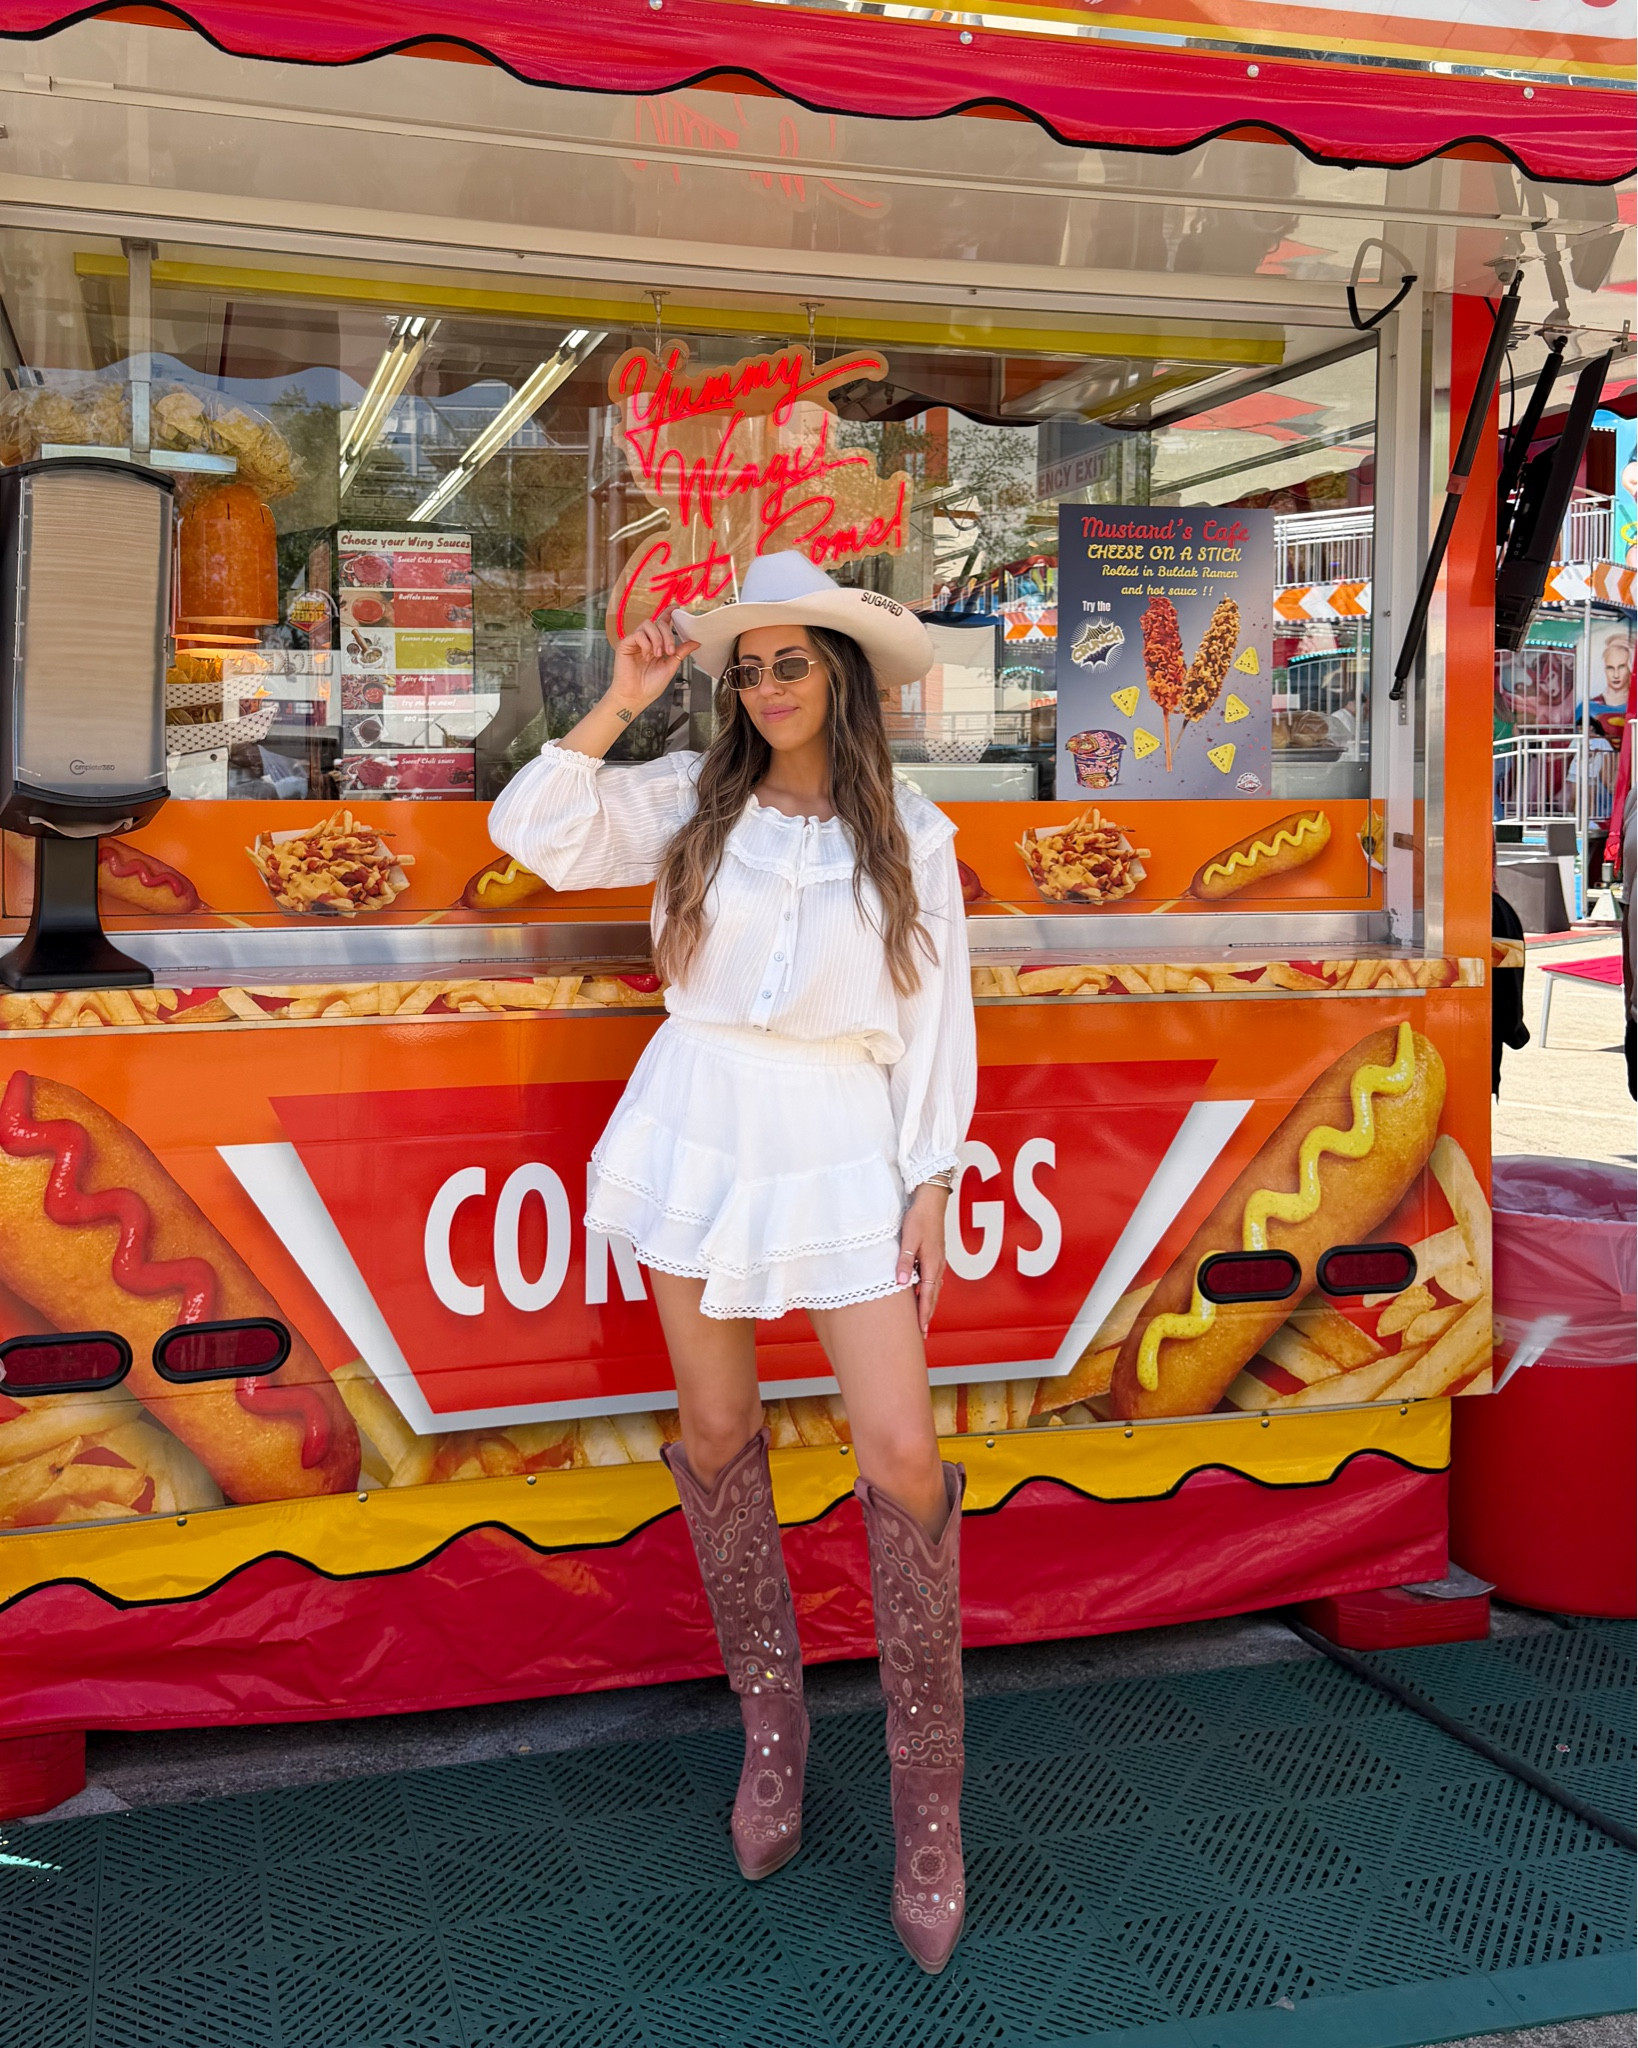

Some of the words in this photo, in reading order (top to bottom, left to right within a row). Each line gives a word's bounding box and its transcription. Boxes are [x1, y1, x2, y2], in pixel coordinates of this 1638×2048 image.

[618, 347, 881, 478] Yummy
[1037, 465, 1072, 497] ENCY
[1075, 454, 1107, 483] EXIT
[341, 534, 378, 546] Choose
[381, 538, 405, 548] your
[408, 536, 434, 550] Wing
[436, 537, 471, 549] Sauces
[1081, 516, 1193, 541] Mustard's
[1203, 520, 1251, 548] Cafe
[417, 556, 433, 564] Chili
[1087, 544, 1144, 560] CHEESE
[1149, 545, 1176, 561] ON
[1179, 546, 1194, 561] A
[1197, 547, 1242, 562] STICK
[1101, 564, 1139, 577] Rolled
[1142, 565, 1154, 577] in
[1157, 565, 1198, 578] Buldak
[1202, 567, 1239, 579] Ramen
[1121, 584, 1143, 595] and
[1146, 584, 1165, 596] hot
[1167, 586, 1198, 596] sauce
[861, 591, 904, 617] SUGARED
[1082, 600, 1096, 613] Try
[1097, 600, 1111, 612] the
[1071, 625, 1126, 664] CRUNCH
[423, 1161, 649, 1318] COR
[943, 1136, 1063, 1281] GS
